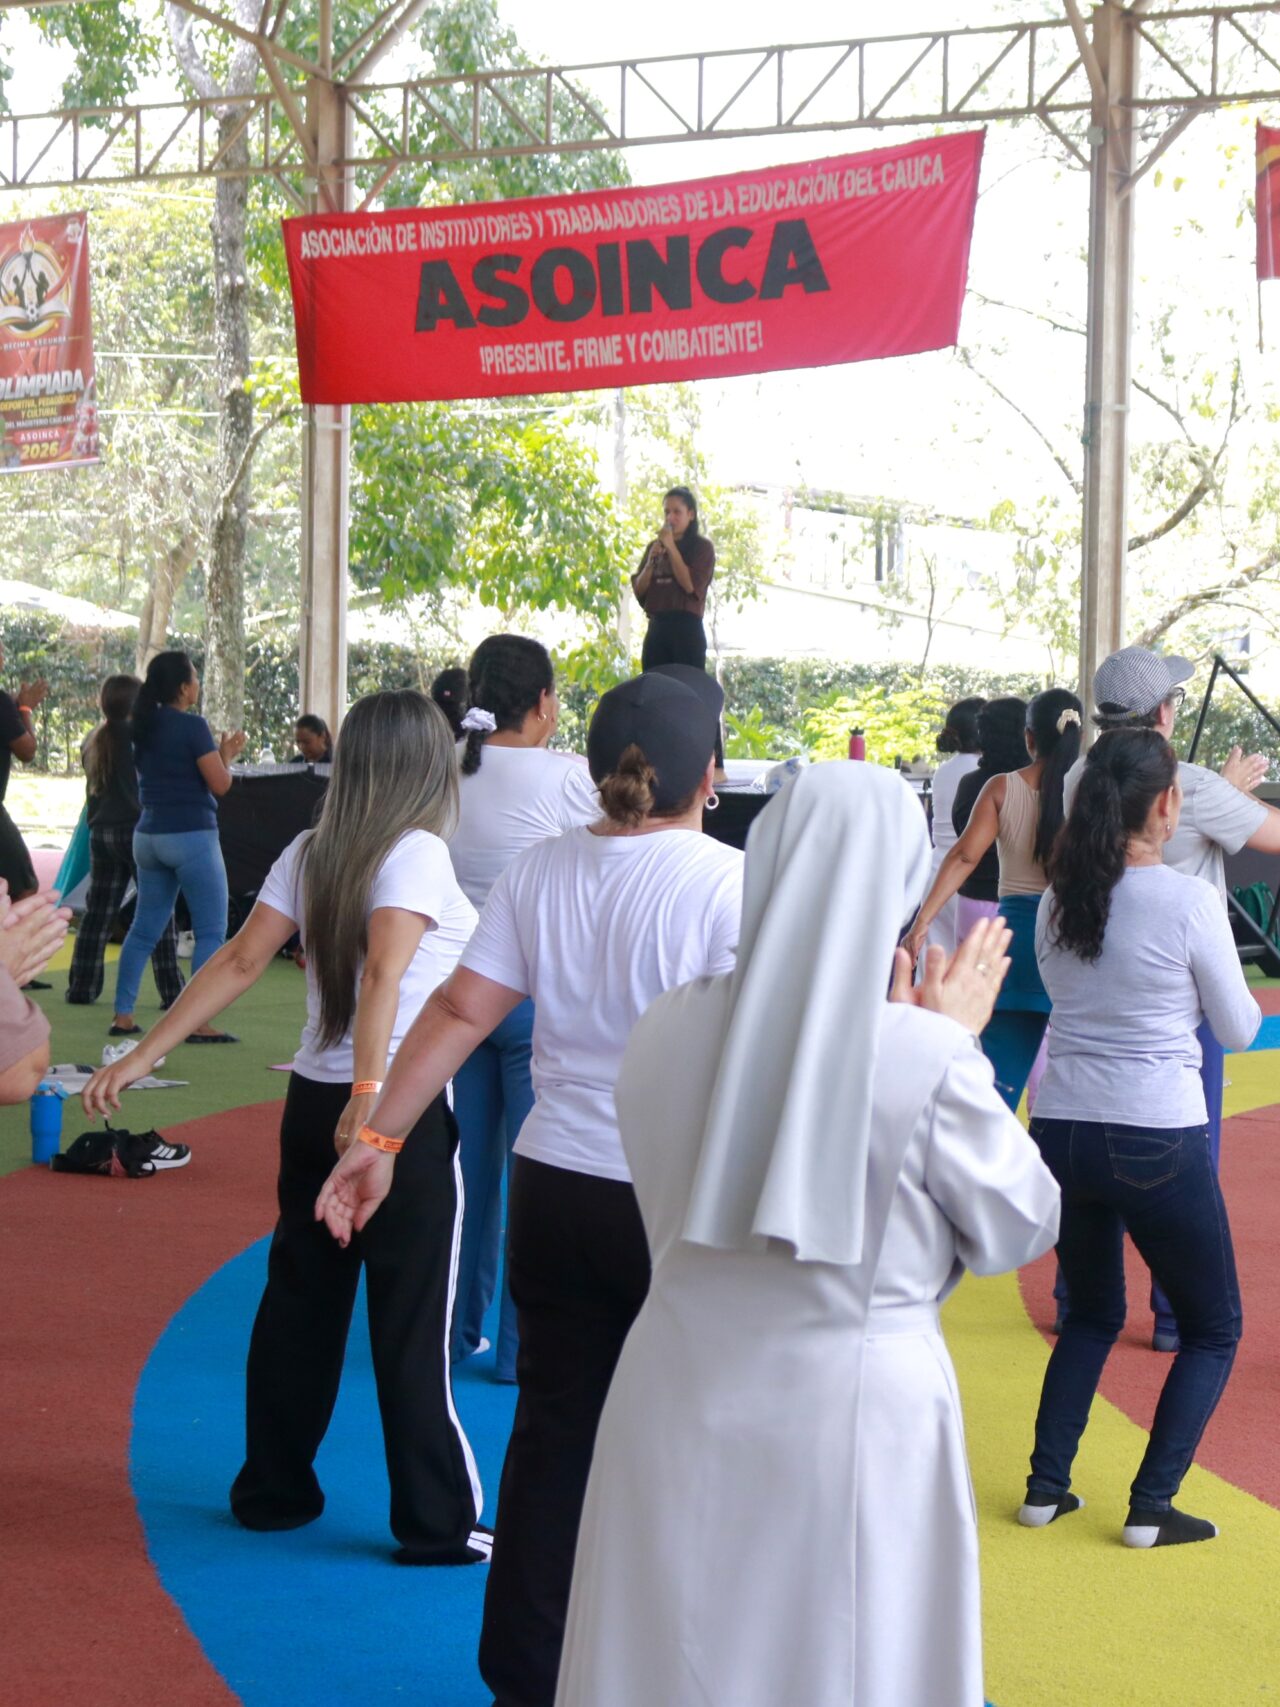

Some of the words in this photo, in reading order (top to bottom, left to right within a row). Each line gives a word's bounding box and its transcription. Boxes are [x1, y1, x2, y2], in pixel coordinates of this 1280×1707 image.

[396, 222, 418, 251] DE
[420, 211, 533, 249] INSTITUTORES
[532, 210, 545, 239] Y
[548, 194, 682, 238] TRABAJADORES
[683, 190, 709, 222] DE
[710, 187, 735, 217] LA
[737, 166, 840, 215] EDUCACIÓN
[842, 166, 879, 200] DEL
[881, 153, 945, 193] CAUCA
[414, 217, 831, 332] ASOINCA
[573, 334, 623, 369] FIRME
[626, 333, 639, 363] Y
[640, 320, 763, 363] COMBATIENTE!
[20, 430, 60, 442] ASOINCA
[21, 441, 59, 460] 2026
